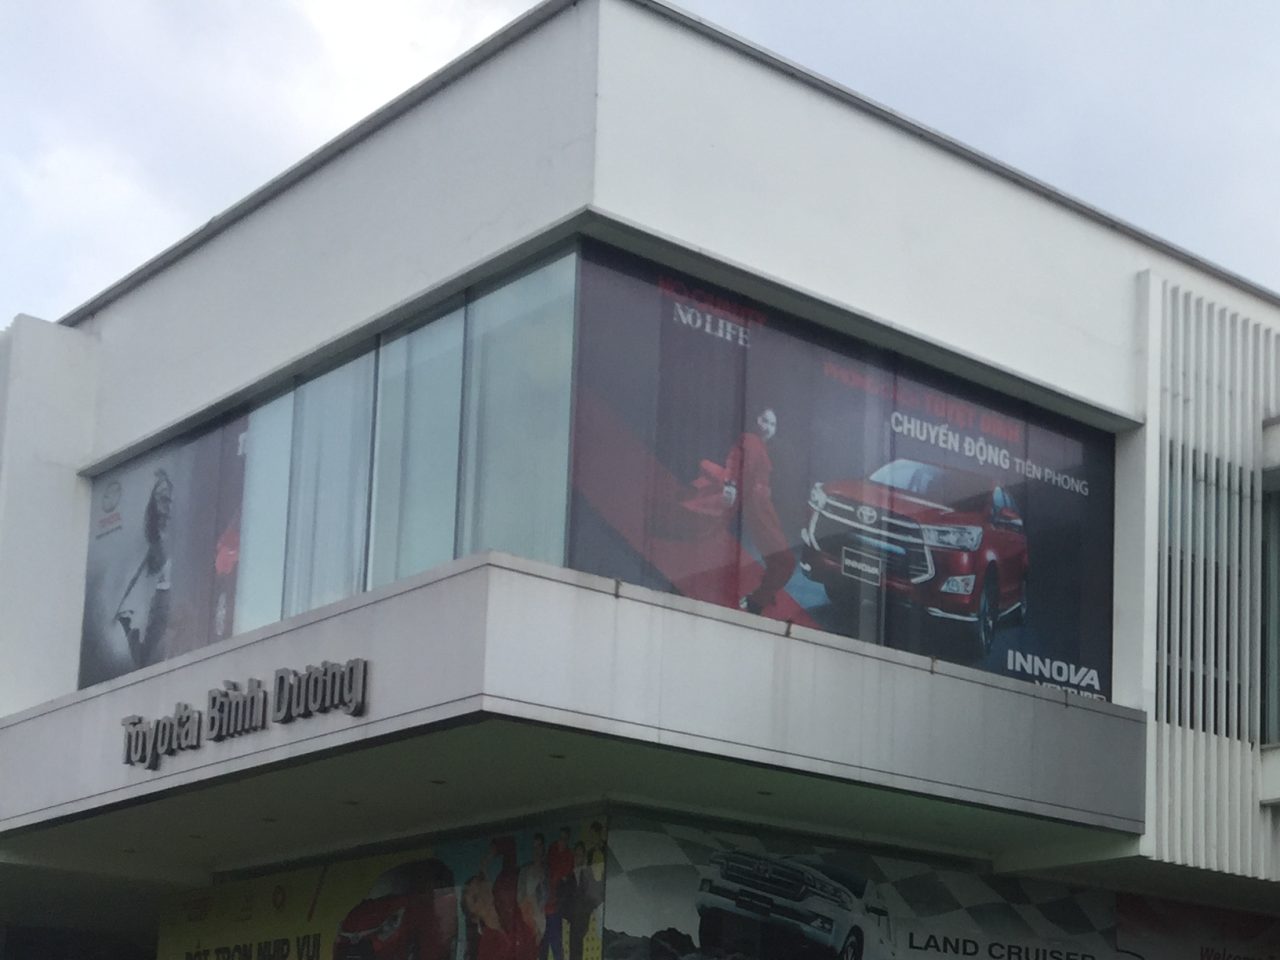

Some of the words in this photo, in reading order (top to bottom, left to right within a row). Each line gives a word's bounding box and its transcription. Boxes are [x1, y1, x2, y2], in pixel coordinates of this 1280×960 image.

[673, 301, 703, 330] NO
[704, 312, 751, 348] LIFE
[962, 435, 1011, 470] ĐỘNG
[1044, 467, 1089, 497] PHONG
[1007, 649, 1101, 691] INNOVA
[121, 702, 201, 770] Toyota
[908, 931, 979, 956] LAND
